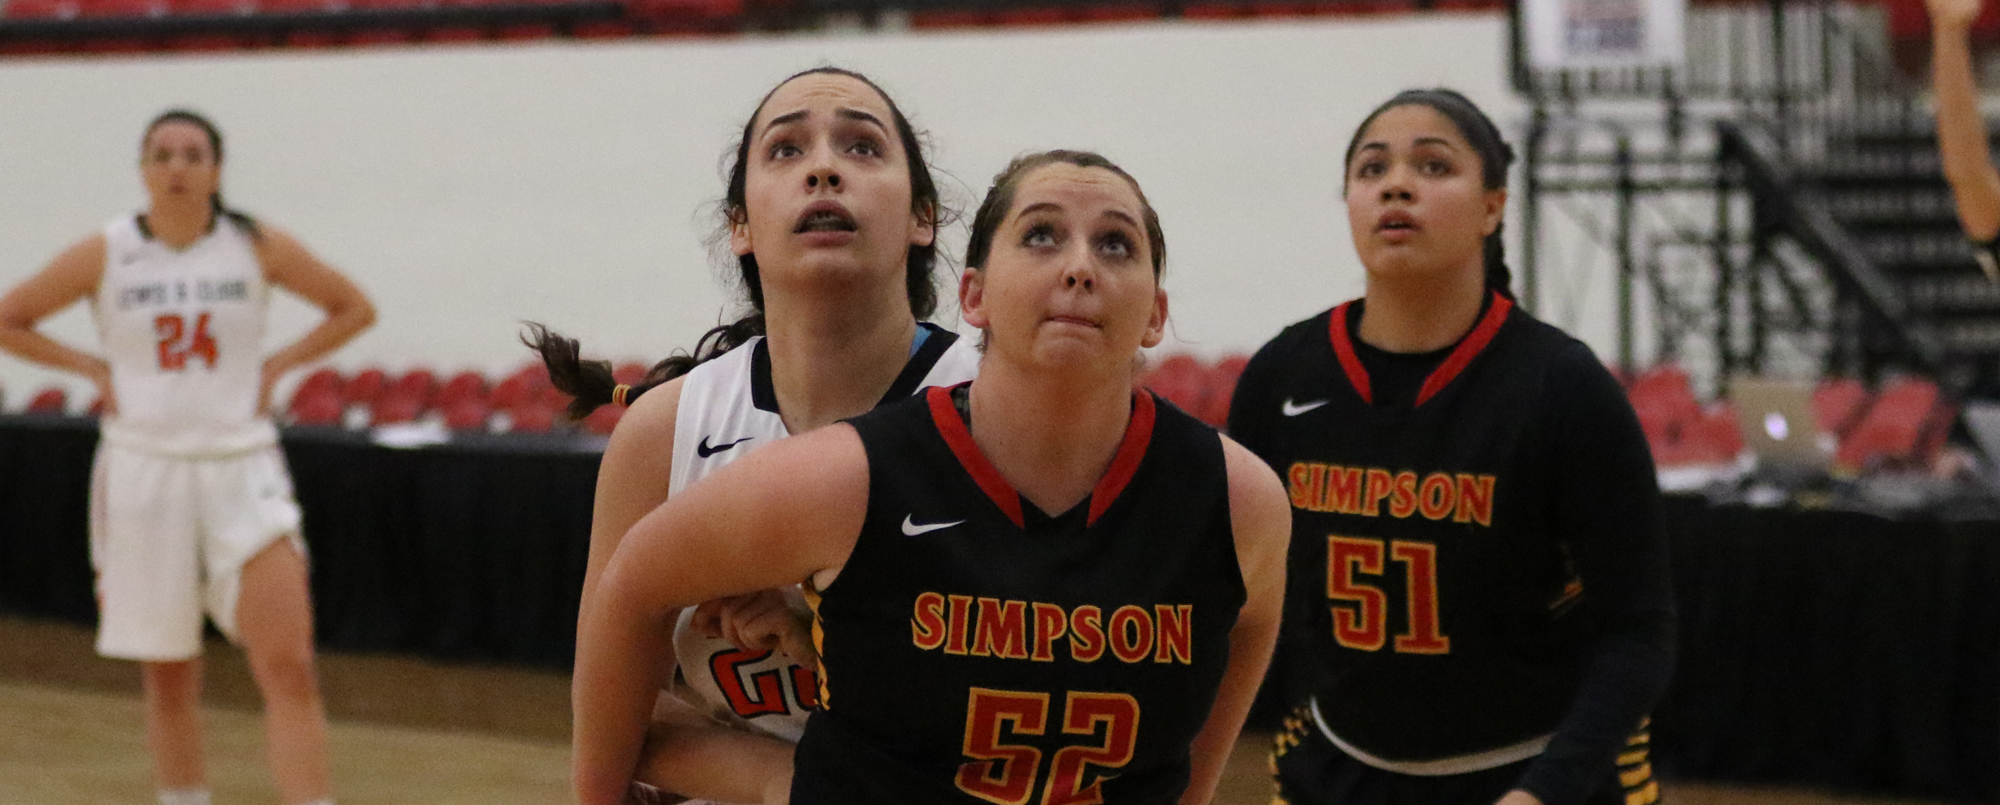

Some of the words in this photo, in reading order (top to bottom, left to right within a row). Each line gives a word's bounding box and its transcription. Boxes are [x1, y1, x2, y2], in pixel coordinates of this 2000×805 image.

[155, 311, 219, 372] 24
[1288, 461, 1497, 527] SIMPSON
[911, 591, 1193, 665] SIMPSON
[1327, 534, 1451, 655] 51
[954, 686, 1141, 805] 52
